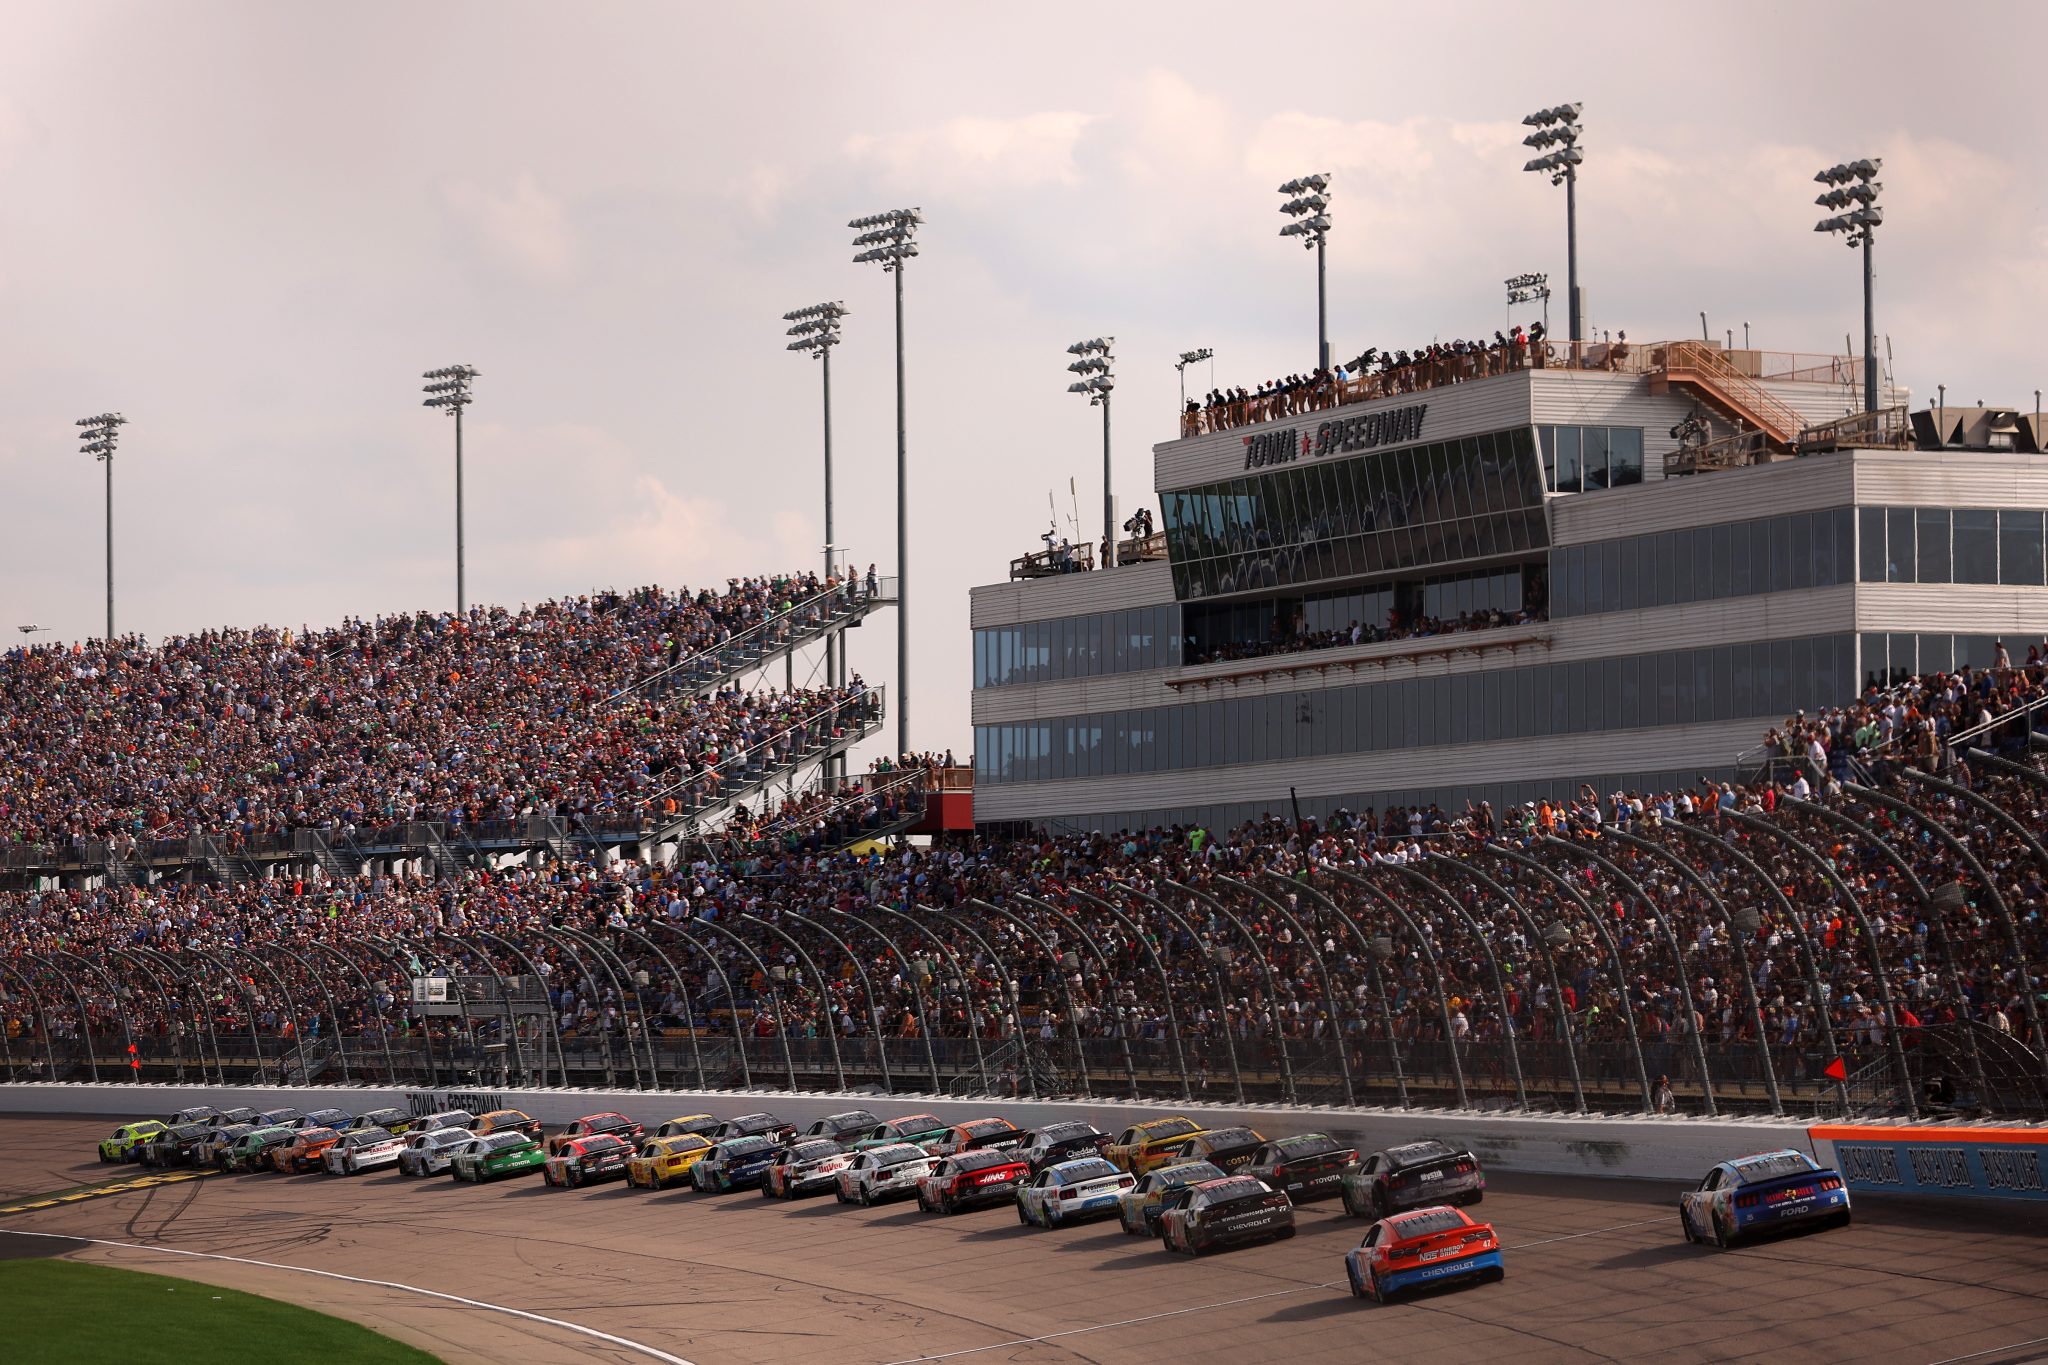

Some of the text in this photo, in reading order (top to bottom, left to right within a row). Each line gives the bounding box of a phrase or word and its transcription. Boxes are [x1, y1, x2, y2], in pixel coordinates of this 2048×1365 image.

[1242, 403, 1428, 470] IOWA SPEEDWAY
[405, 1093, 438, 1116] IOWA
[512, 1159, 531, 1168] TOYOTA
[1226, 1155, 1251, 1166] COSTA
[605, 1162, 625, 1172] TOYOTA
[980, 1171, 1008, 1183] HAAS
[1314, 1174, 1341, 1185] TOYOTA
[986, 1185, 1007, 1193] FORD
[1092, 1198, 1113, 1208] FORD
[1781, 1205, 1809, 1217] FORD
[1228, 1217, 1271, 1231] CHEVROLET
[1483, 1239, 1491, 1248] 47
[1419, 1243, 1465, 1262] NOS ENERGY
[1422, 1261, 1475, 1278] CHEVROLET
